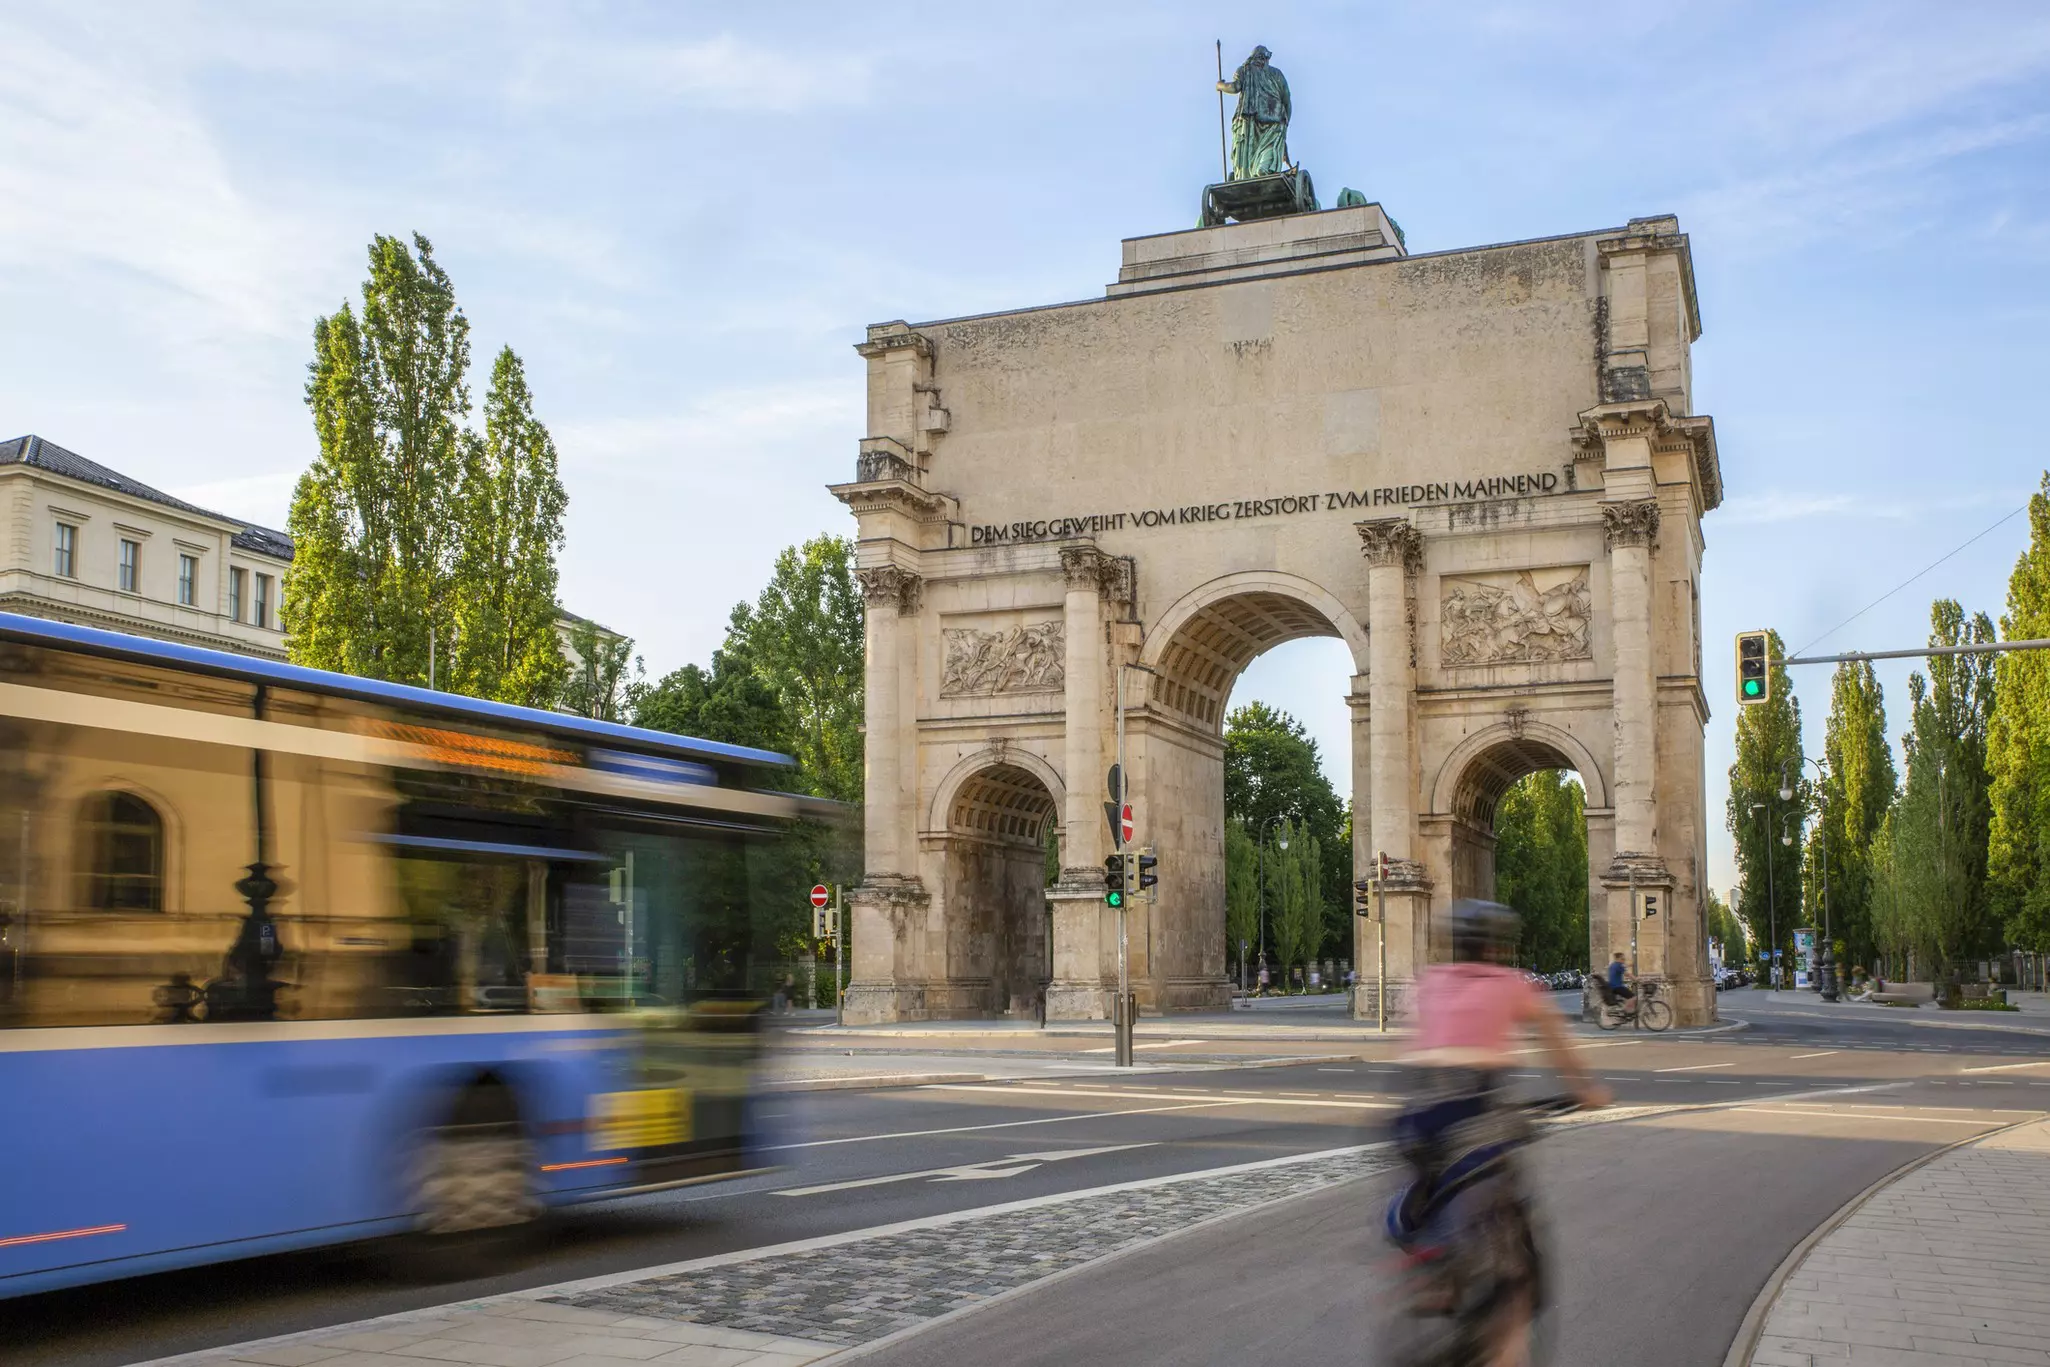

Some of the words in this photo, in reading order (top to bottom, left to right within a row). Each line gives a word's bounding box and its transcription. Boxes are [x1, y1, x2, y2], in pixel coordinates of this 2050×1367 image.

[971, 525, 1008, 543] DEM
[1011, 520, 1048, 539] SIEG
[1048, 513, 1127, 536] GEWEIHT
[1131, 508, 1175, 528] VOM
[1180, 503, 1230, 524] KRIEG
[1233, 495, 1320, 519] ZERSTÖRT
[1325, 490, 1369, 511] ZVM
[1373, 482, 1449, 506] FRIEDEN
[1453, 473, 1557, 500] MAHNEND
